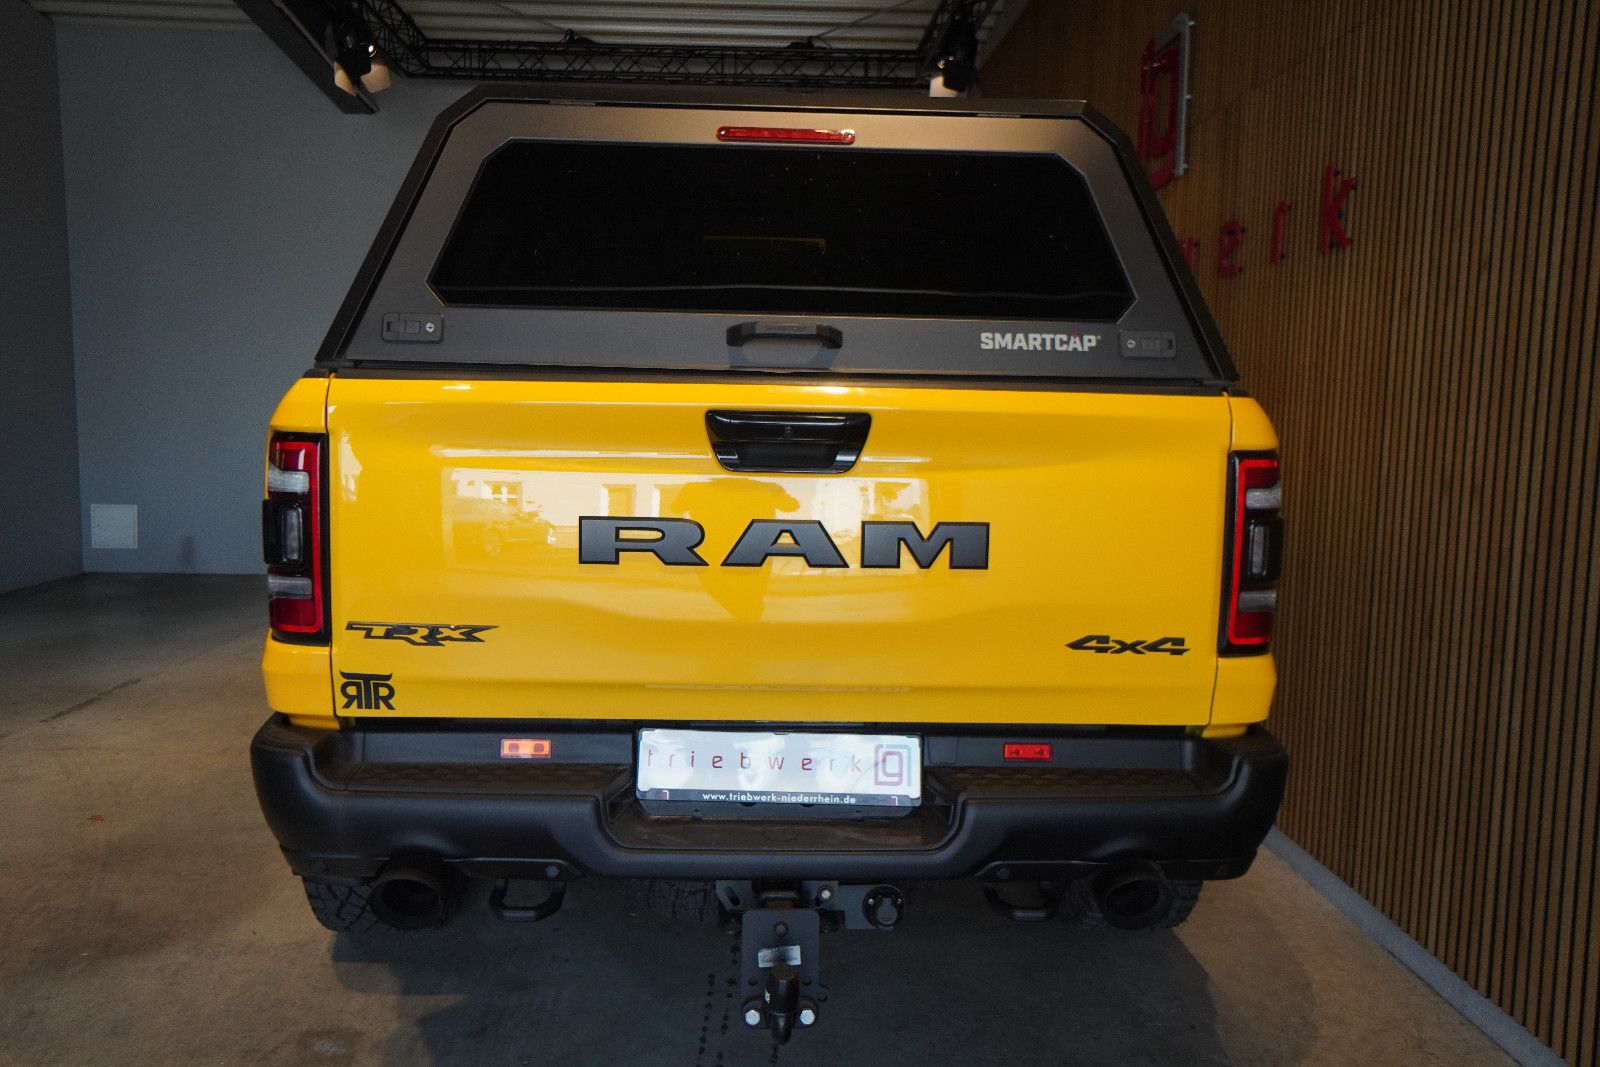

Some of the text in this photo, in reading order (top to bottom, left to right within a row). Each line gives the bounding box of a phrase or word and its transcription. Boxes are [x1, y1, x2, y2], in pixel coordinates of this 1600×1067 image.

[980, 332, 1097, 351] SMARTCAP
[579, 515, 990, 569] RAM
[345, 621, 499, 647] TRX
[1065, 635, 1190, 655] 4x4
[702, 791, 856, 804] www.triebwerk-niederrhein.de
